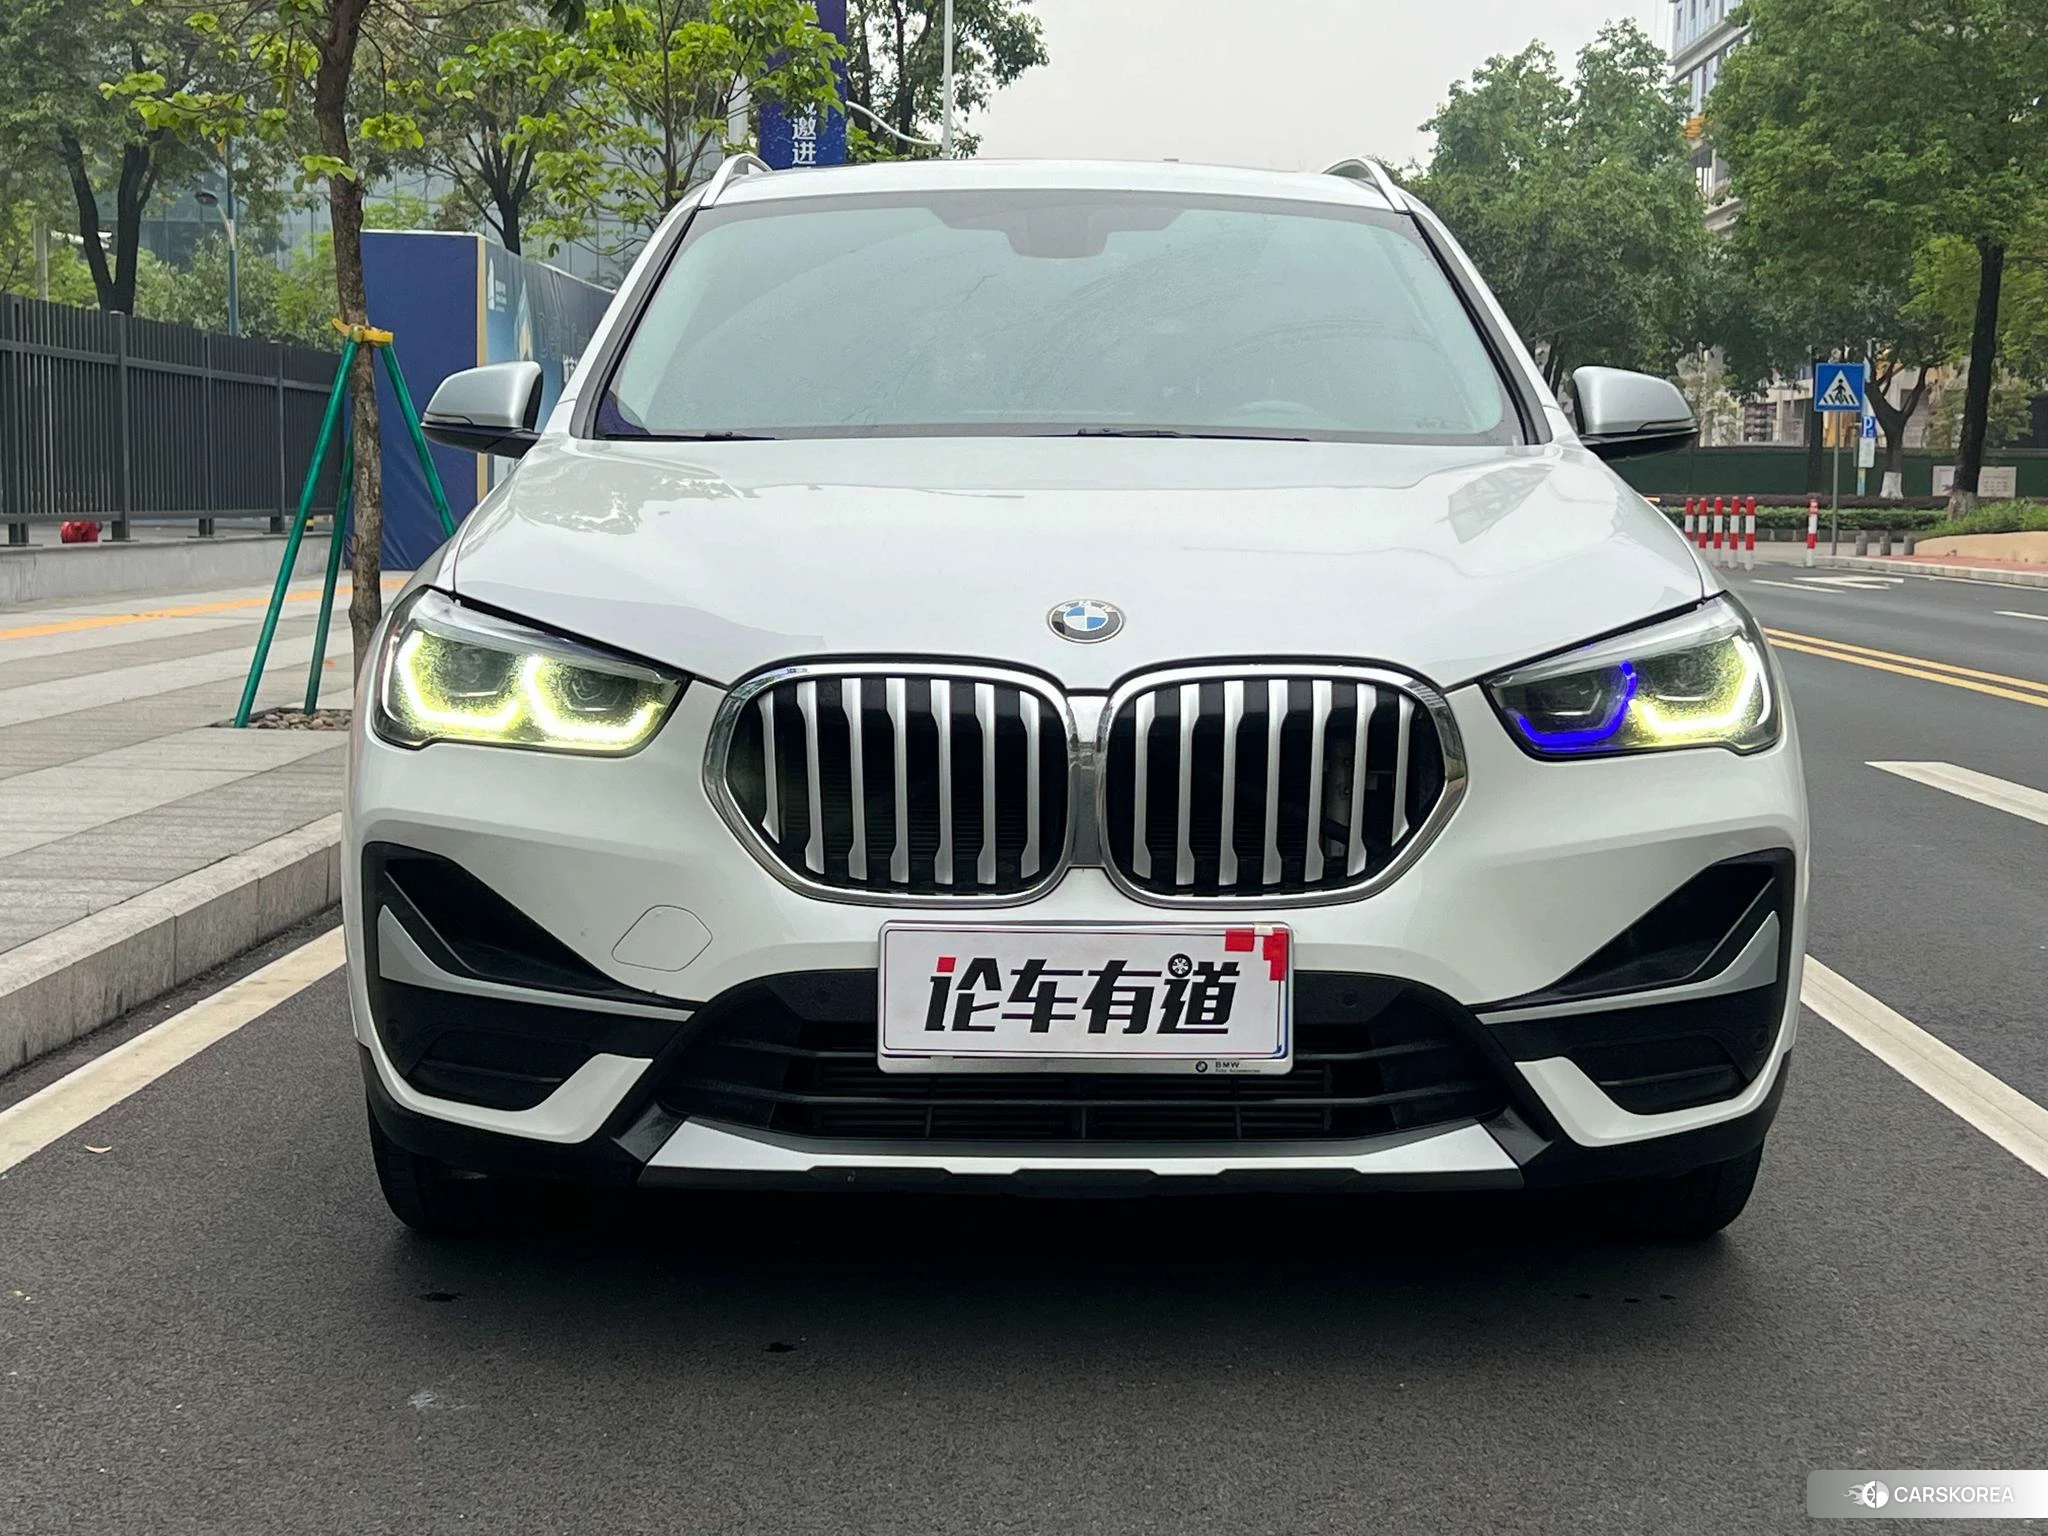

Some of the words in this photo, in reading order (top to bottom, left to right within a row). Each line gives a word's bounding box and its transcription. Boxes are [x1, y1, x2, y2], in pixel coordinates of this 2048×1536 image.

[791, 101, 817, 168] 邀进
[1863, 416, 1873, 437] P
[924, 953, 1240, 1035] 论车有道
